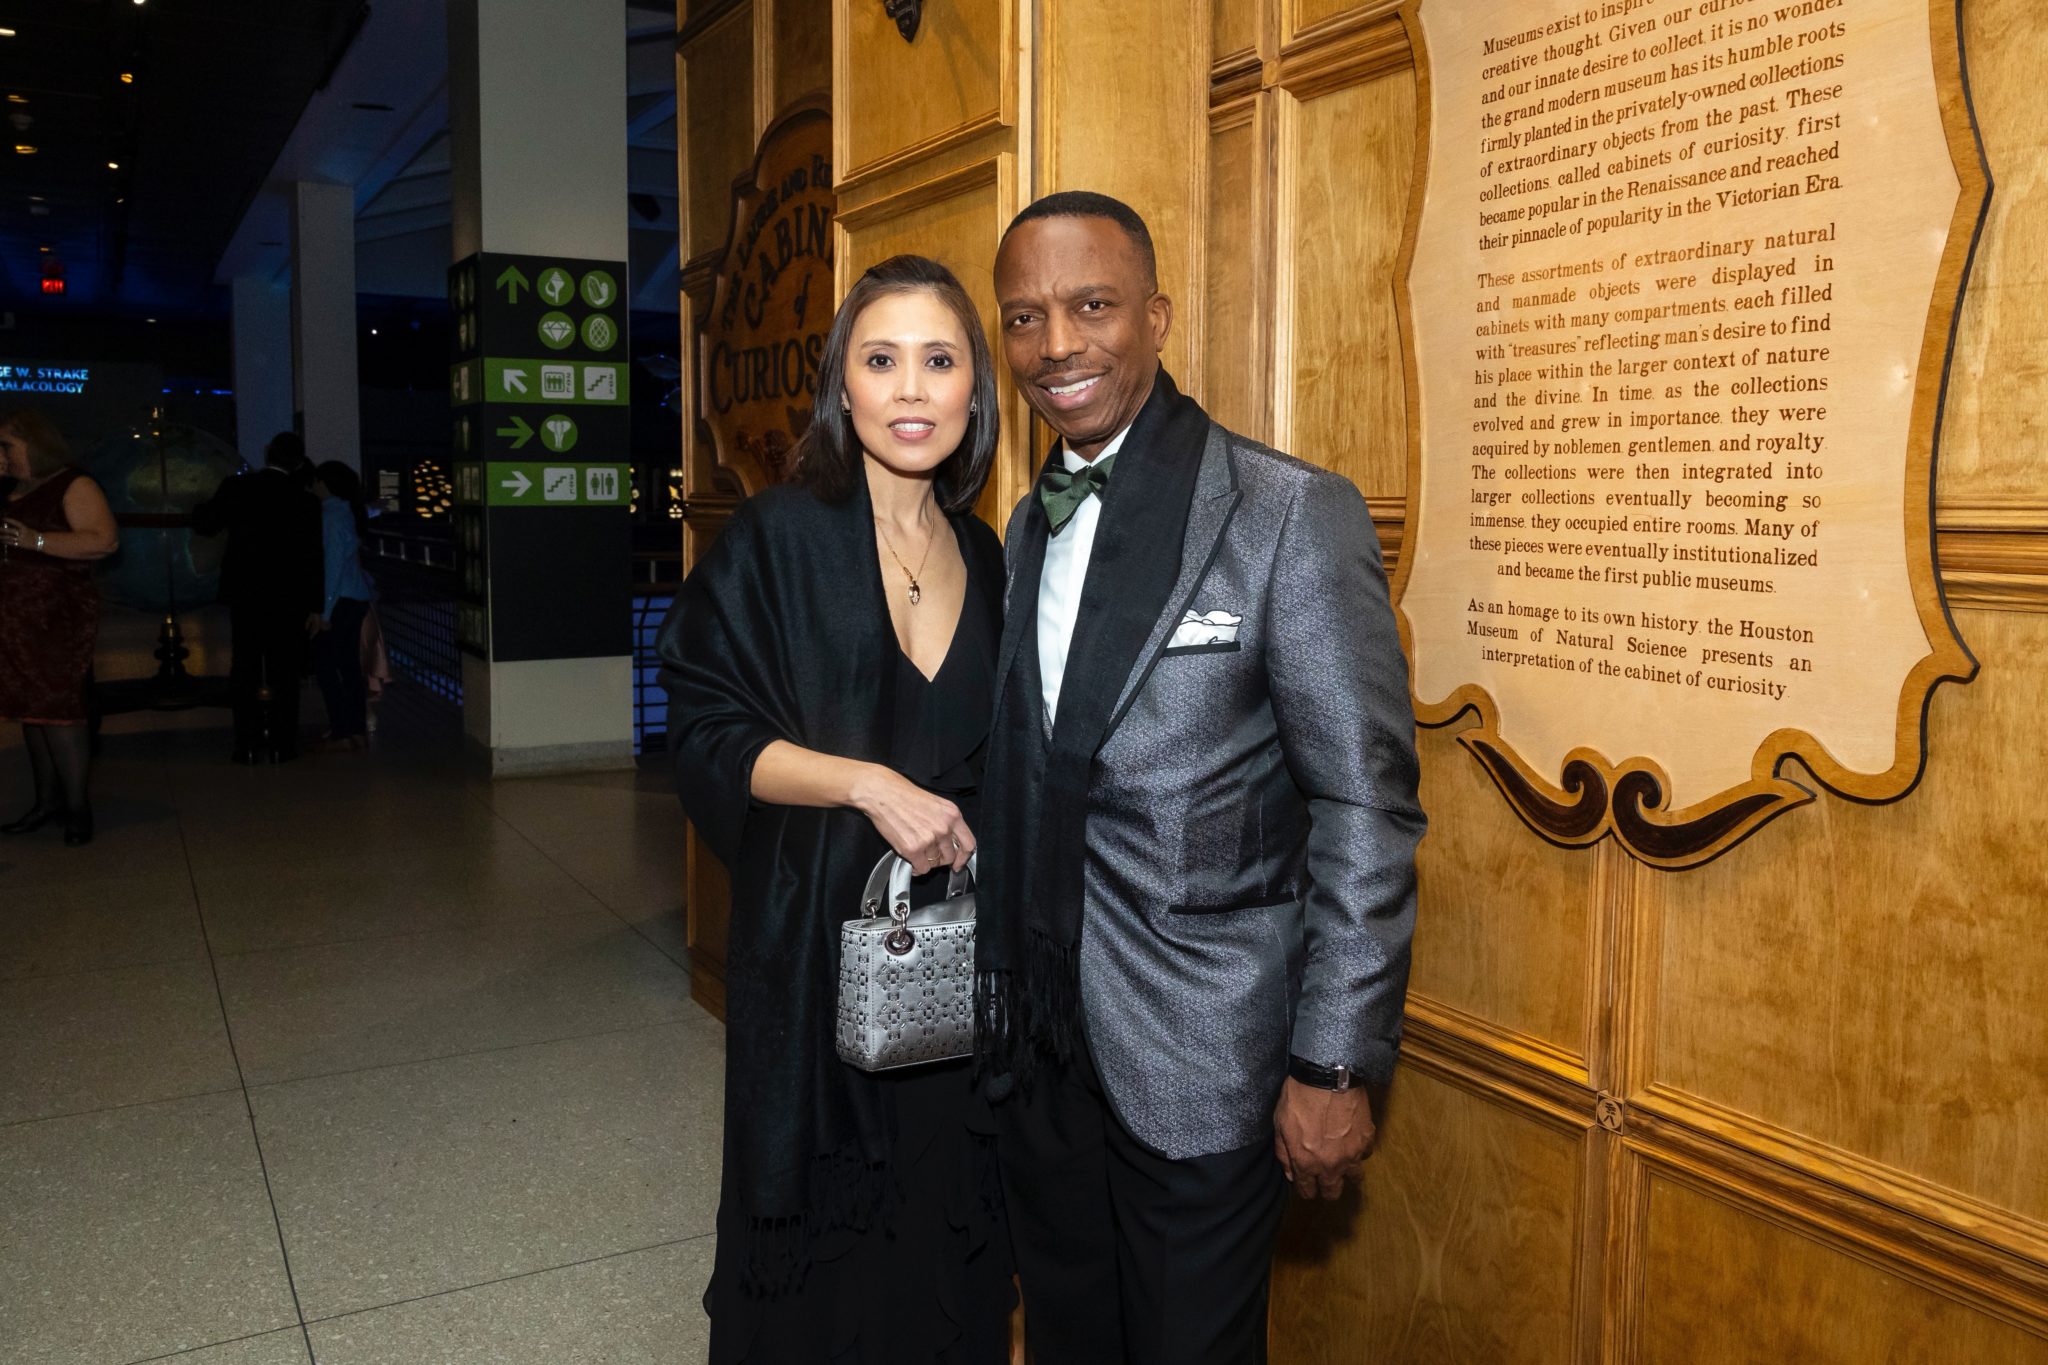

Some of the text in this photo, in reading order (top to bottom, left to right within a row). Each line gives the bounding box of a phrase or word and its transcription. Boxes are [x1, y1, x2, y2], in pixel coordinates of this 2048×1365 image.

[1482, 7, 1693, 80] creative Given our
[1483, 8, 1598, 56] Museums exist to
[1481, 14, 1769, 105] and our innate desire to it is no
[1481, 21, 1846, 130] the grand modern museum has its humble roots
[1480, 53, 1844, 154] firmly planted the privately-owned collections
[1480, 160, 1494, 178] of
[1497, 140, 1598, 175] extraordinary
[1602, 126, 1656, 151] objects
[1661, 118, 1699, 138] from
[1705, 108, 1733, 128] the
[1786, 84, 1843, 109] These
[1557, 112, 1841, 186] called cabinets of first
[1479, 140, 1840, 227] became popular the Renaissance and reached
[1478, 232, 1509, 251] their
[1511, 221, 1567, 249] pinnacle
[1586, 206, 1664, 236] popularity
[1667, 201, 1683, 219] in
[1686, 196, 1712, 215] the
[1715, 182, 1801, 209] Victorian
[744, 201, 833, 330] CABIN
[1477, 222, 1836, 289] These assortments of extraordinary natural
[1476, 254, 1834, 313] and manmade objects were displayed in
[1476, 282, 1833, 337] cabinets with many each filled
[1475, 312, 1831, 360] with reflecting man's desire to find
[0, 366, 89, 380] E W. STRAKE
[711, 333, 828, 414] CURIOS
[1474, 346, 1830, 387] his place within the larger context of nature
[1505, 391, 1527, 407] the
[1592, 386, 1609, 403] In
[1664, 386, 1682, 399] as
[1693, 379, 1720, 398] the
[1730, 374, 1828, 396] collections
[1472, 405, 1827, 433] evolved and grew they were
[1472, 433, 1751, 459] acquired by and
[1471, 461, 1823, 484] The collections were then integrated into
[1470, 488, 1822, 513] larger collections eventually becoming so
[1469, 535, 1818, 567] these pieces eventually institutionalized
[1531, 513, 1561, 533] they
[1564, 515, 1629, 535] occupied
[1632, 514, 1682, 534] entire
[1743, 518, 1795, 541] Many
[1800, 519, 1821, 538] of
[1497, 561, 1522, 577] and
[1525, 561, 1575, 580] became
[1578, 565, 1601, 582] the
[1604, 566, 1639, 585] first
[1642, 569, 1692, 589] public
[1467, 597, 1814, 644] As an homage own the Houston
[1466, 620, 1813, 672] Museum of Natural Science presents an
[1481, 645, 1576, 671] interpretation
[1578, 657, 1594, 673] of
[1597, 659, 1621, 677] the
[1624, 663, 1682, 685] cabinet
[1685, 670, 1703, 687] of
